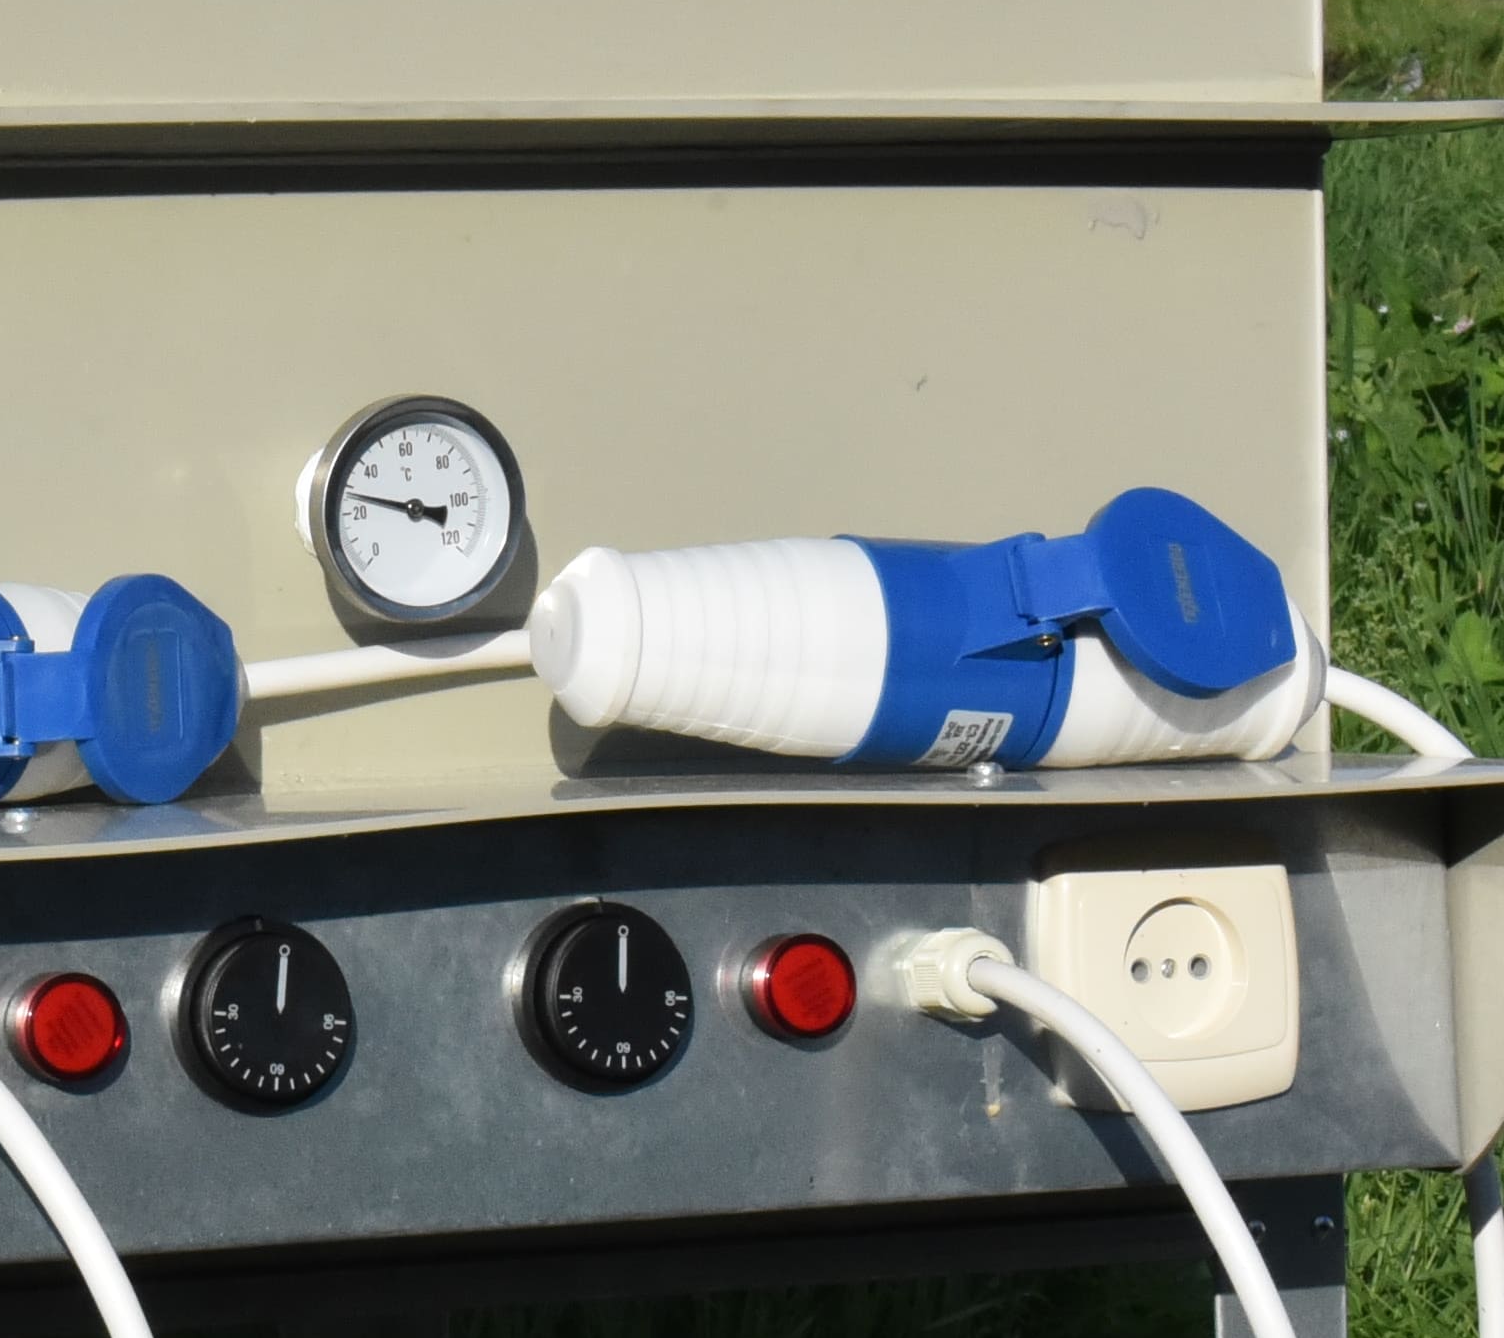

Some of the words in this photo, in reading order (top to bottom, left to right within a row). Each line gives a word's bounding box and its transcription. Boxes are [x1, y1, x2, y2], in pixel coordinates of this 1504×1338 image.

[398, 441, 413, 457] 60
[435, 454, 450, 470] 80
[363, 464, 378, 479] 40
[449, 492, 469, 508] 100
[353, 505, 367, 520] 20
[441, 529, 460, 546] 120
[372, 542, 380, 557] 0
[572, 986, 583, 1003] 30
[227, 1003, 239, 1020] 30
[616, 1042, 631, 1053] 60
[269, 1063, 285, 1075] 60
